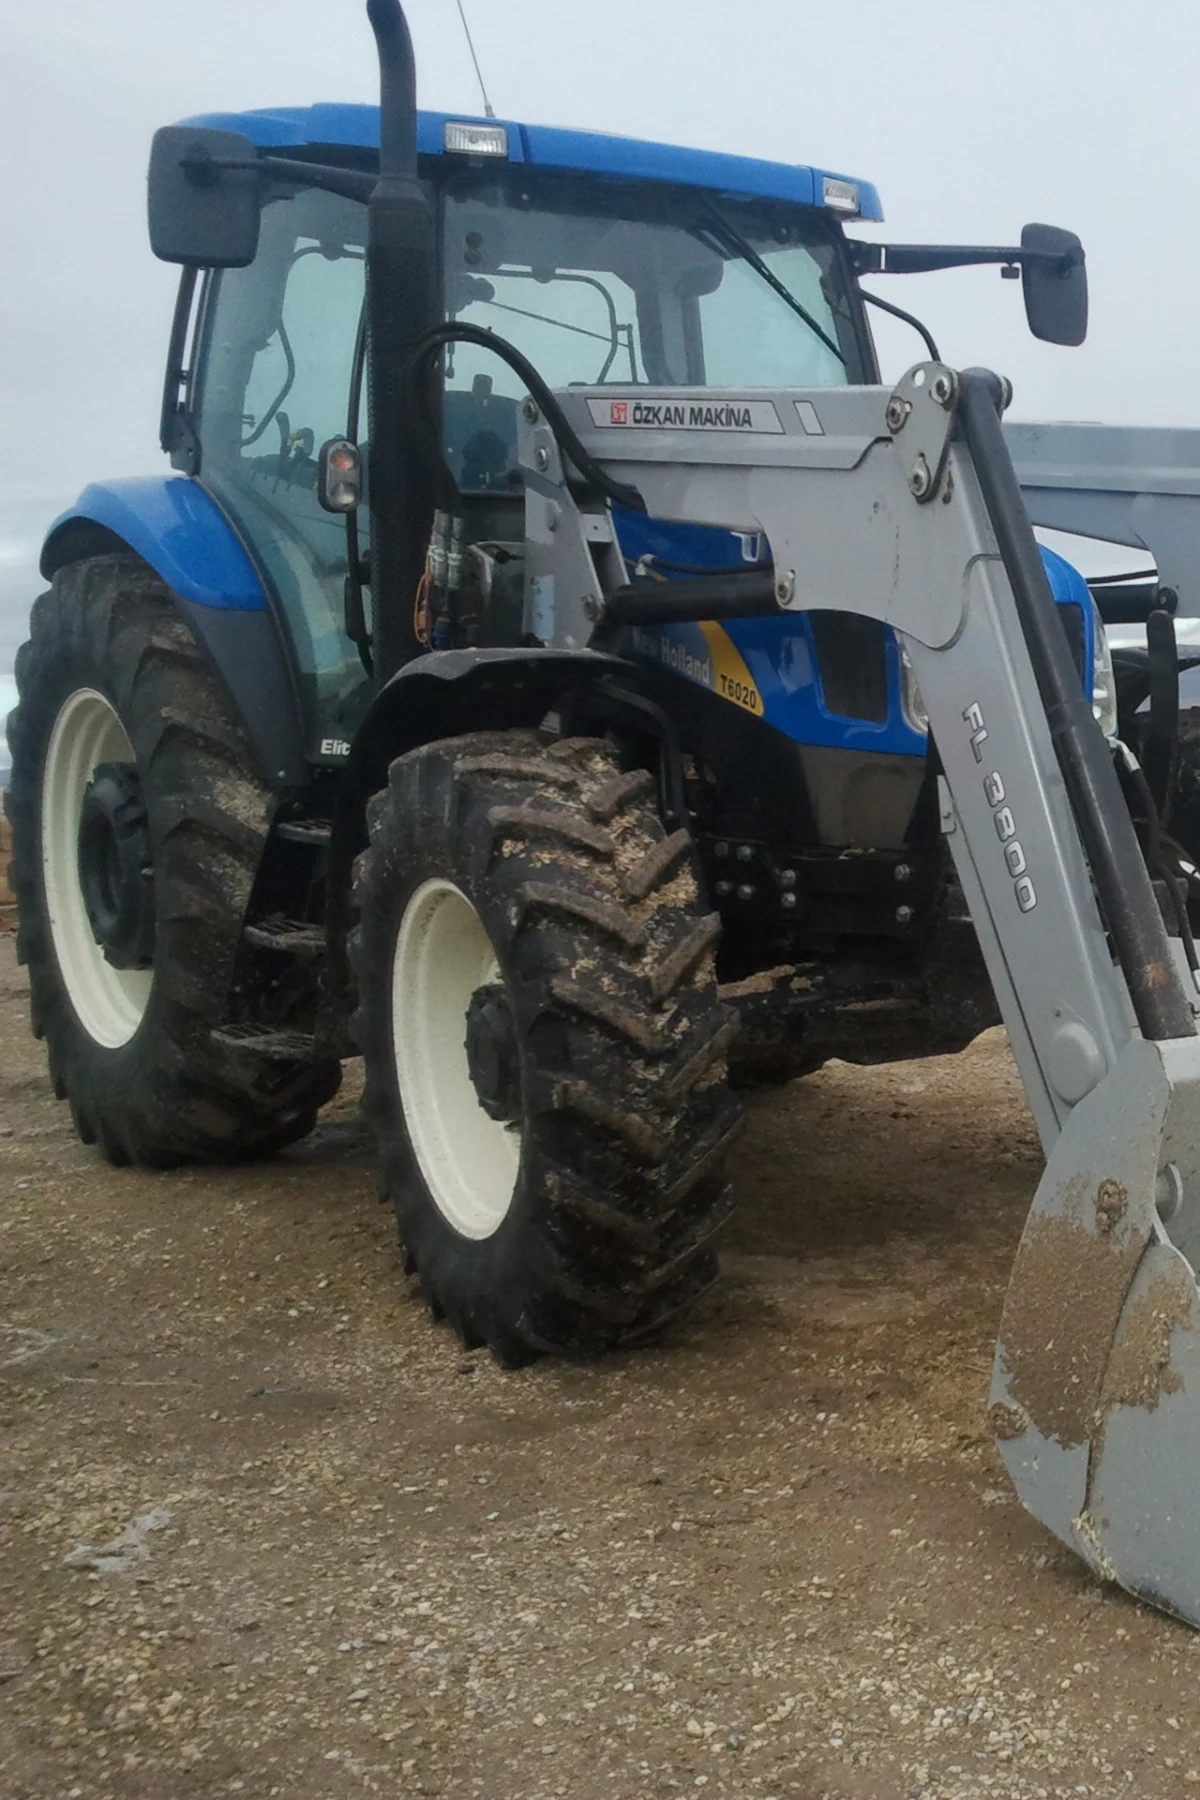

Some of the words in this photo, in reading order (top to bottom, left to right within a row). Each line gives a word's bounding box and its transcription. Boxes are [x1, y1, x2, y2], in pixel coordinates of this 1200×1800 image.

[633, 403, 685, 424] ÖZKAN
[690, 404, 752, 427] MAKİNA
[661, 636, 710, 684] Holland
[720, 674, 757, 709] T6020
[320, 739, 351, 756] Elit
[962, 700, 989, 764] FL
[983, 771, 1037, 914] 3800
